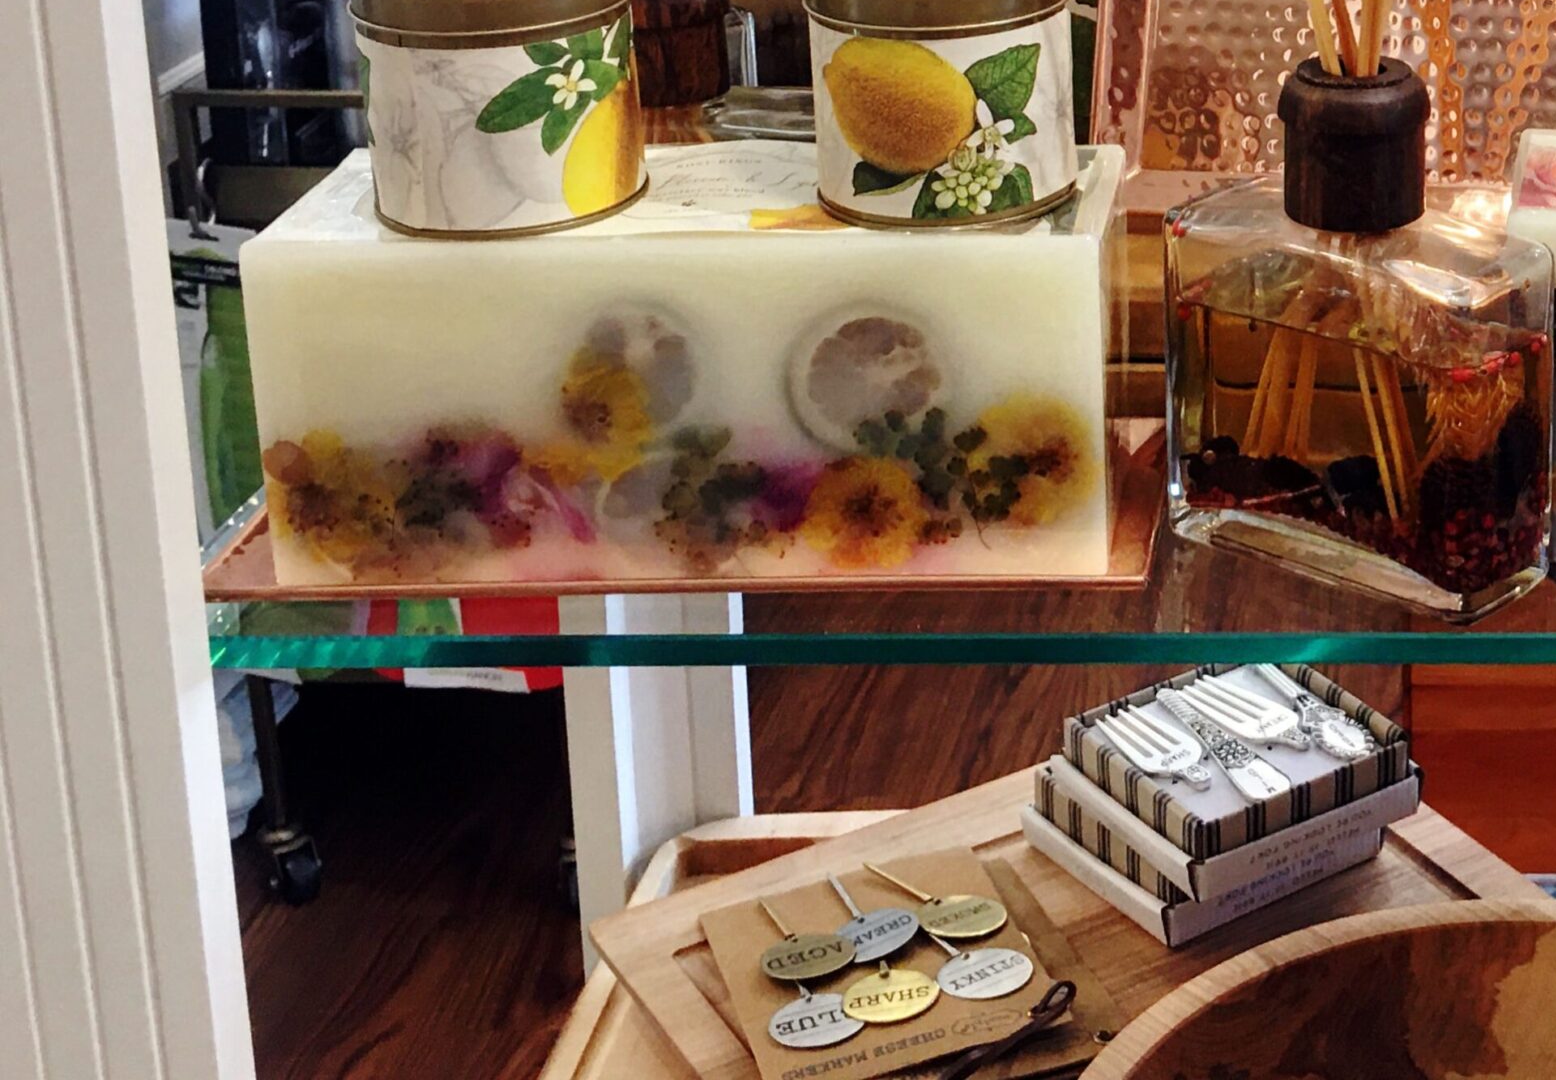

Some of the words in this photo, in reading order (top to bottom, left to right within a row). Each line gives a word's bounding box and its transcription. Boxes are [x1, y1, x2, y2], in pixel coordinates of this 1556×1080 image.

[1160, 748, 1191, 769] SHARP
[851, 913, 913, 948] CREAM
[765, 939, 843, 971] AGED
[948, 953, 1026, 992] STINKY
[848, 984, 931, 1011] SHARP
[776, 1006, 849, 1037] LUE
[873, 1026, 946, 1060] CHEESE
[781, 1049, 868, 1080] MARKERS
